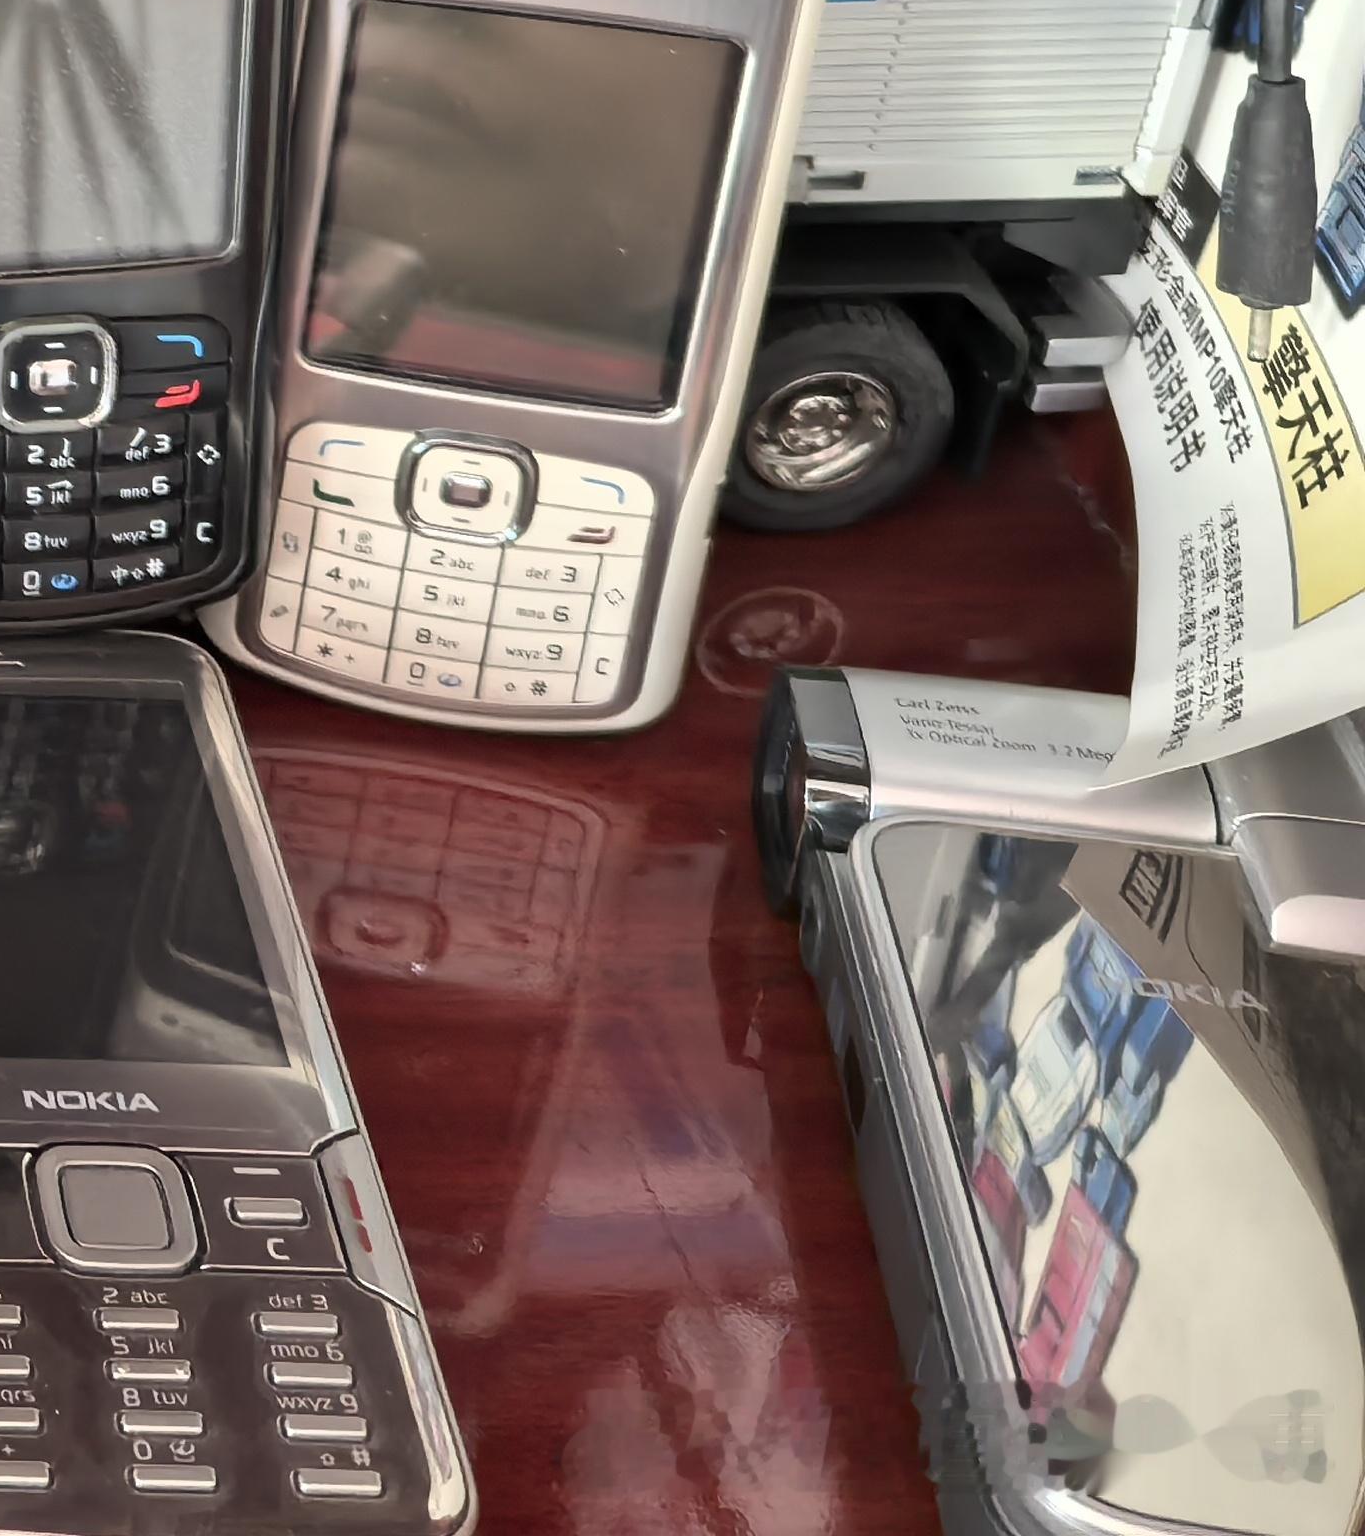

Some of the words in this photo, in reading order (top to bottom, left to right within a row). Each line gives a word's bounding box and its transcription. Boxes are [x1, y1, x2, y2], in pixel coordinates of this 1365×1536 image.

[1135, 297, 1207, 472] 使用说明书
[1262, 323, 1350, 510] 擎天柱
[153, 434, 172, 454] 3
[27, 445, 45, 463] 2
[26, 486, 43, 505] 5
[120, 484, 149, 499] mno
[151, 475, 171, 496] 6
[149, 519, 169, 540] 9
[24, 531, 42, 551] 8
[430, 549, 446, 566] 2
[325, 566, 342, 582] 4
[560, 565, 577, 583] 3
[422, 585, 438, 602] 5
[321, 605, 337, 622] 7
[553, 605, 570, 623] 6
[415, 628, 432, 645] 8
[546, 644, 564, 662] 9
[1076, 747, 1116, 763] Meg
[1097, 976, 1269, 1012] OKIA
[22, 1089, 160, 1113] NOKIA
[102, 1287, 119, 1304] 2
[130, 1287, 168, 1305] abc
[268, 1293, 303, 1309] def
[311, 1294, 329, 1310] 3
[111, 1338, 128, 1354] 5
[270, 1343, 319, 1358] mno
[326, 1342, 344, 1361] 6
[122, 1388, 140, 1407] 8
[152, 1389, 188, 1406] tuv
[276, 1394, 332, 1412] wxyz
[340, 1394, 358, 1414] 9
